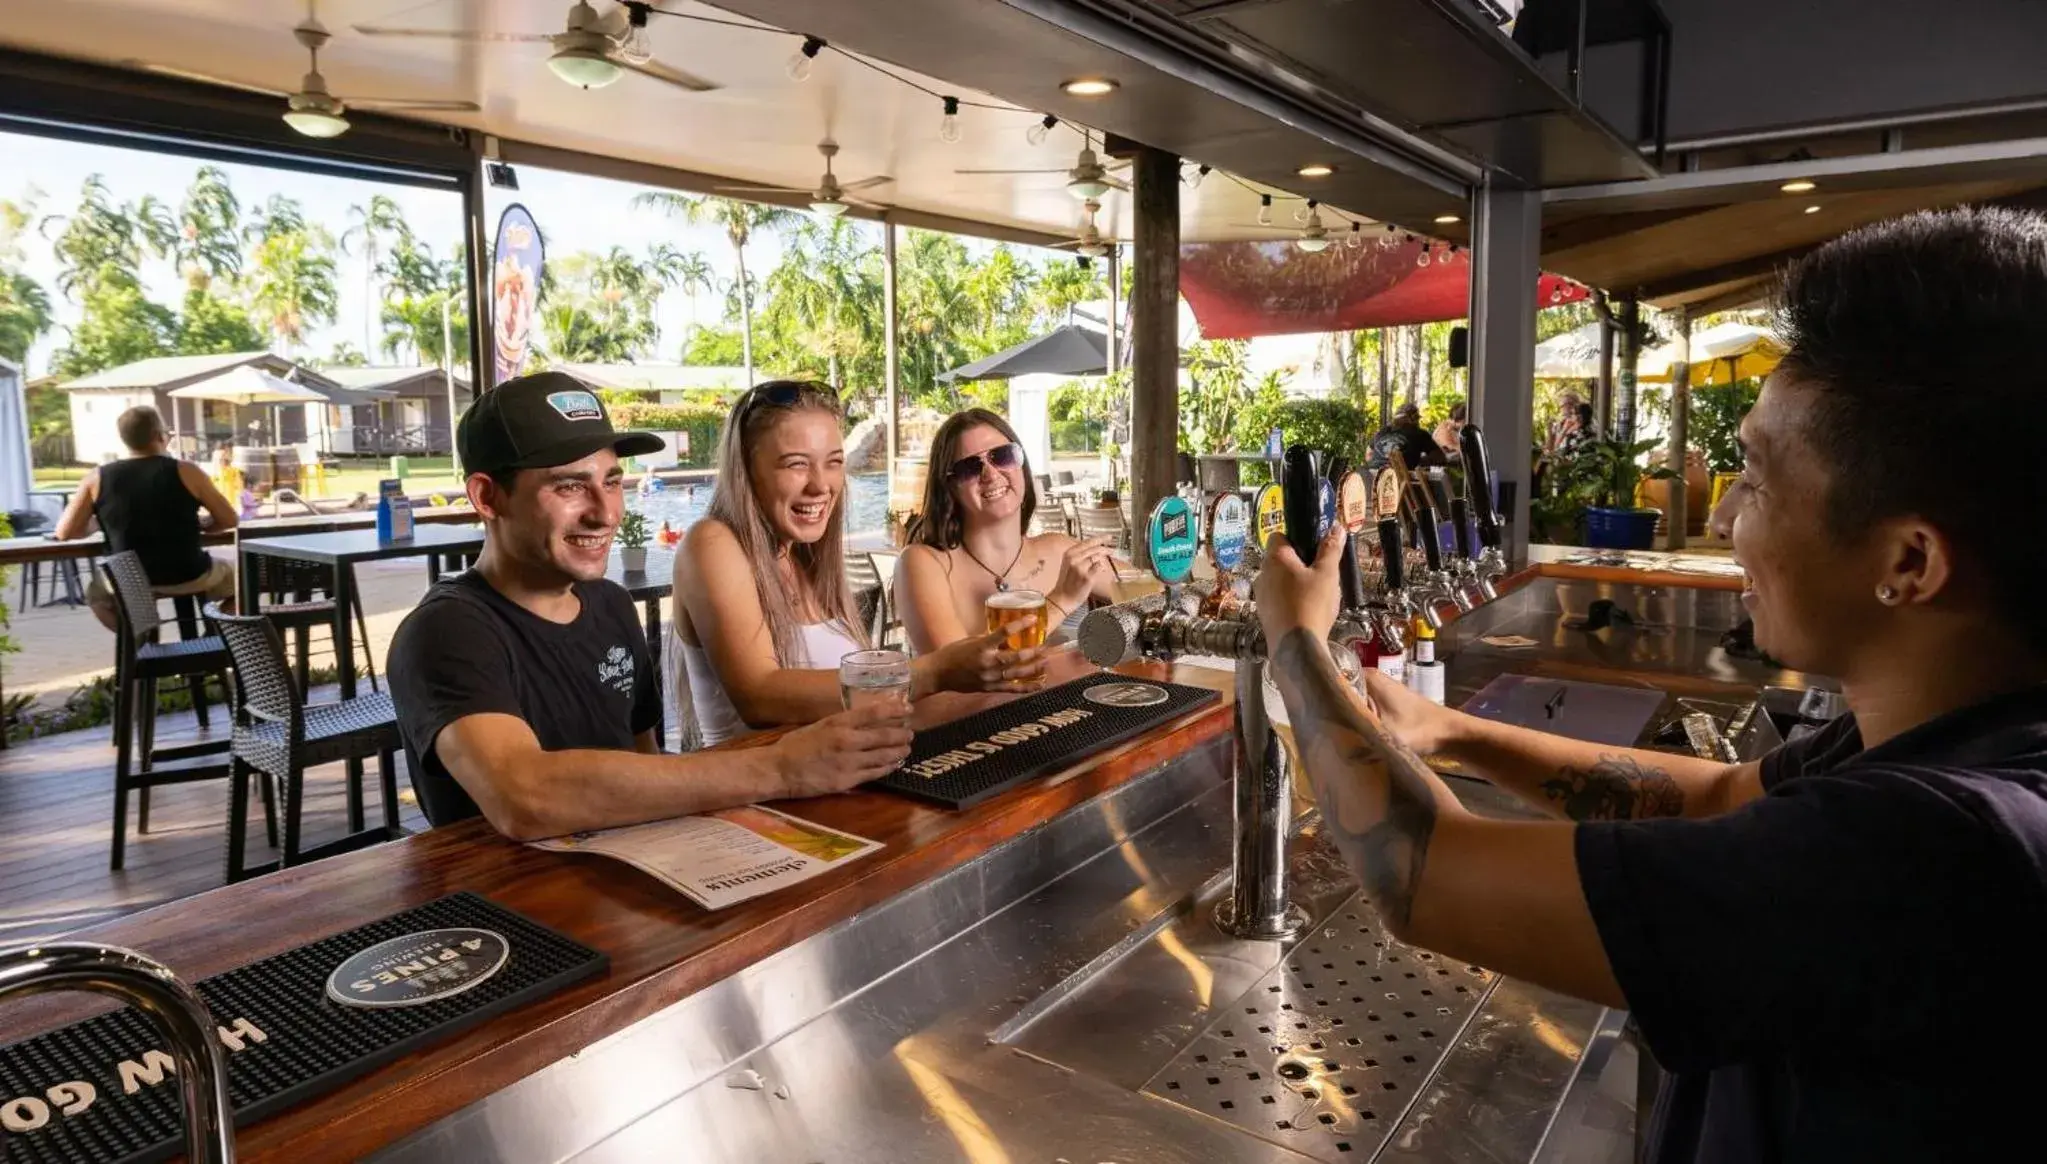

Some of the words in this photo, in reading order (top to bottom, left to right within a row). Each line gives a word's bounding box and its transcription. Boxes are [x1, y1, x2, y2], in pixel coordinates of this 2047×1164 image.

[1038, 707, 1093, 729] HOW
[988, 722, 1049, 746] GOOD
[965, 740, 1003, 756] IS
[705, 860, 808, 892] elements
[461, 937, 482, 951] 4
[350, 947, 461, 993] PINES
[117, 1017, 268, 1095] HW
